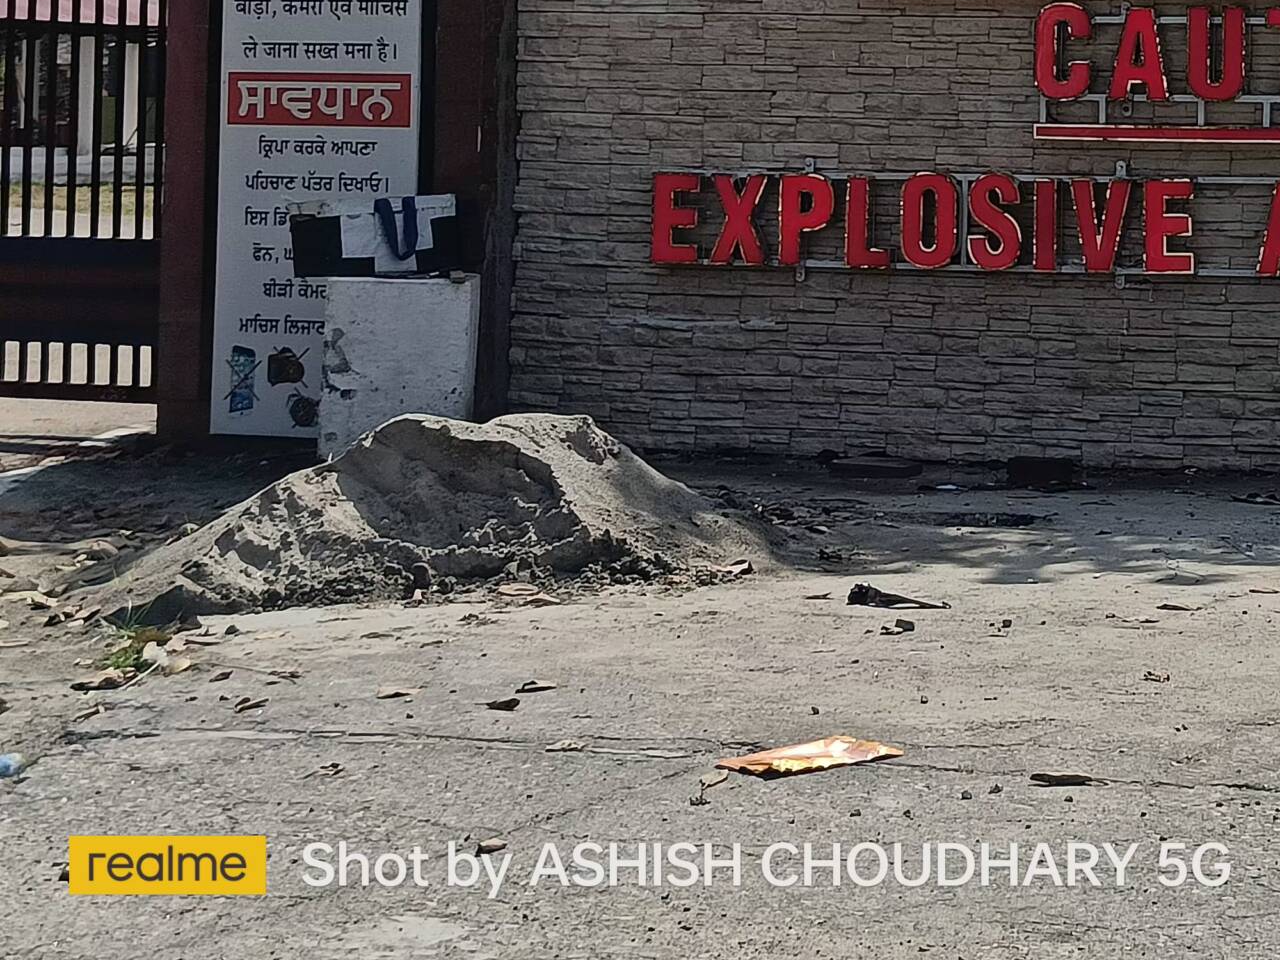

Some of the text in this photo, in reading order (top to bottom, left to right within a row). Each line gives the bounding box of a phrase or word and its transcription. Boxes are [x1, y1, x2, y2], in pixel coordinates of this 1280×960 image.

[242, 35, 258, 59] ले
[262, 41, 298, 59] जाना
[302, 41, 339, 60] सख्त
[343, 42, 373, 60] मना
[237, 80, 402, 121] ਸਾਵਧਾਨ
[293, 135, 327, 156] ਕਰਕੇ
[244, 205, 270, 226] ਇਸ
[650, 170, 1198, 277] EXPLOSIVE
